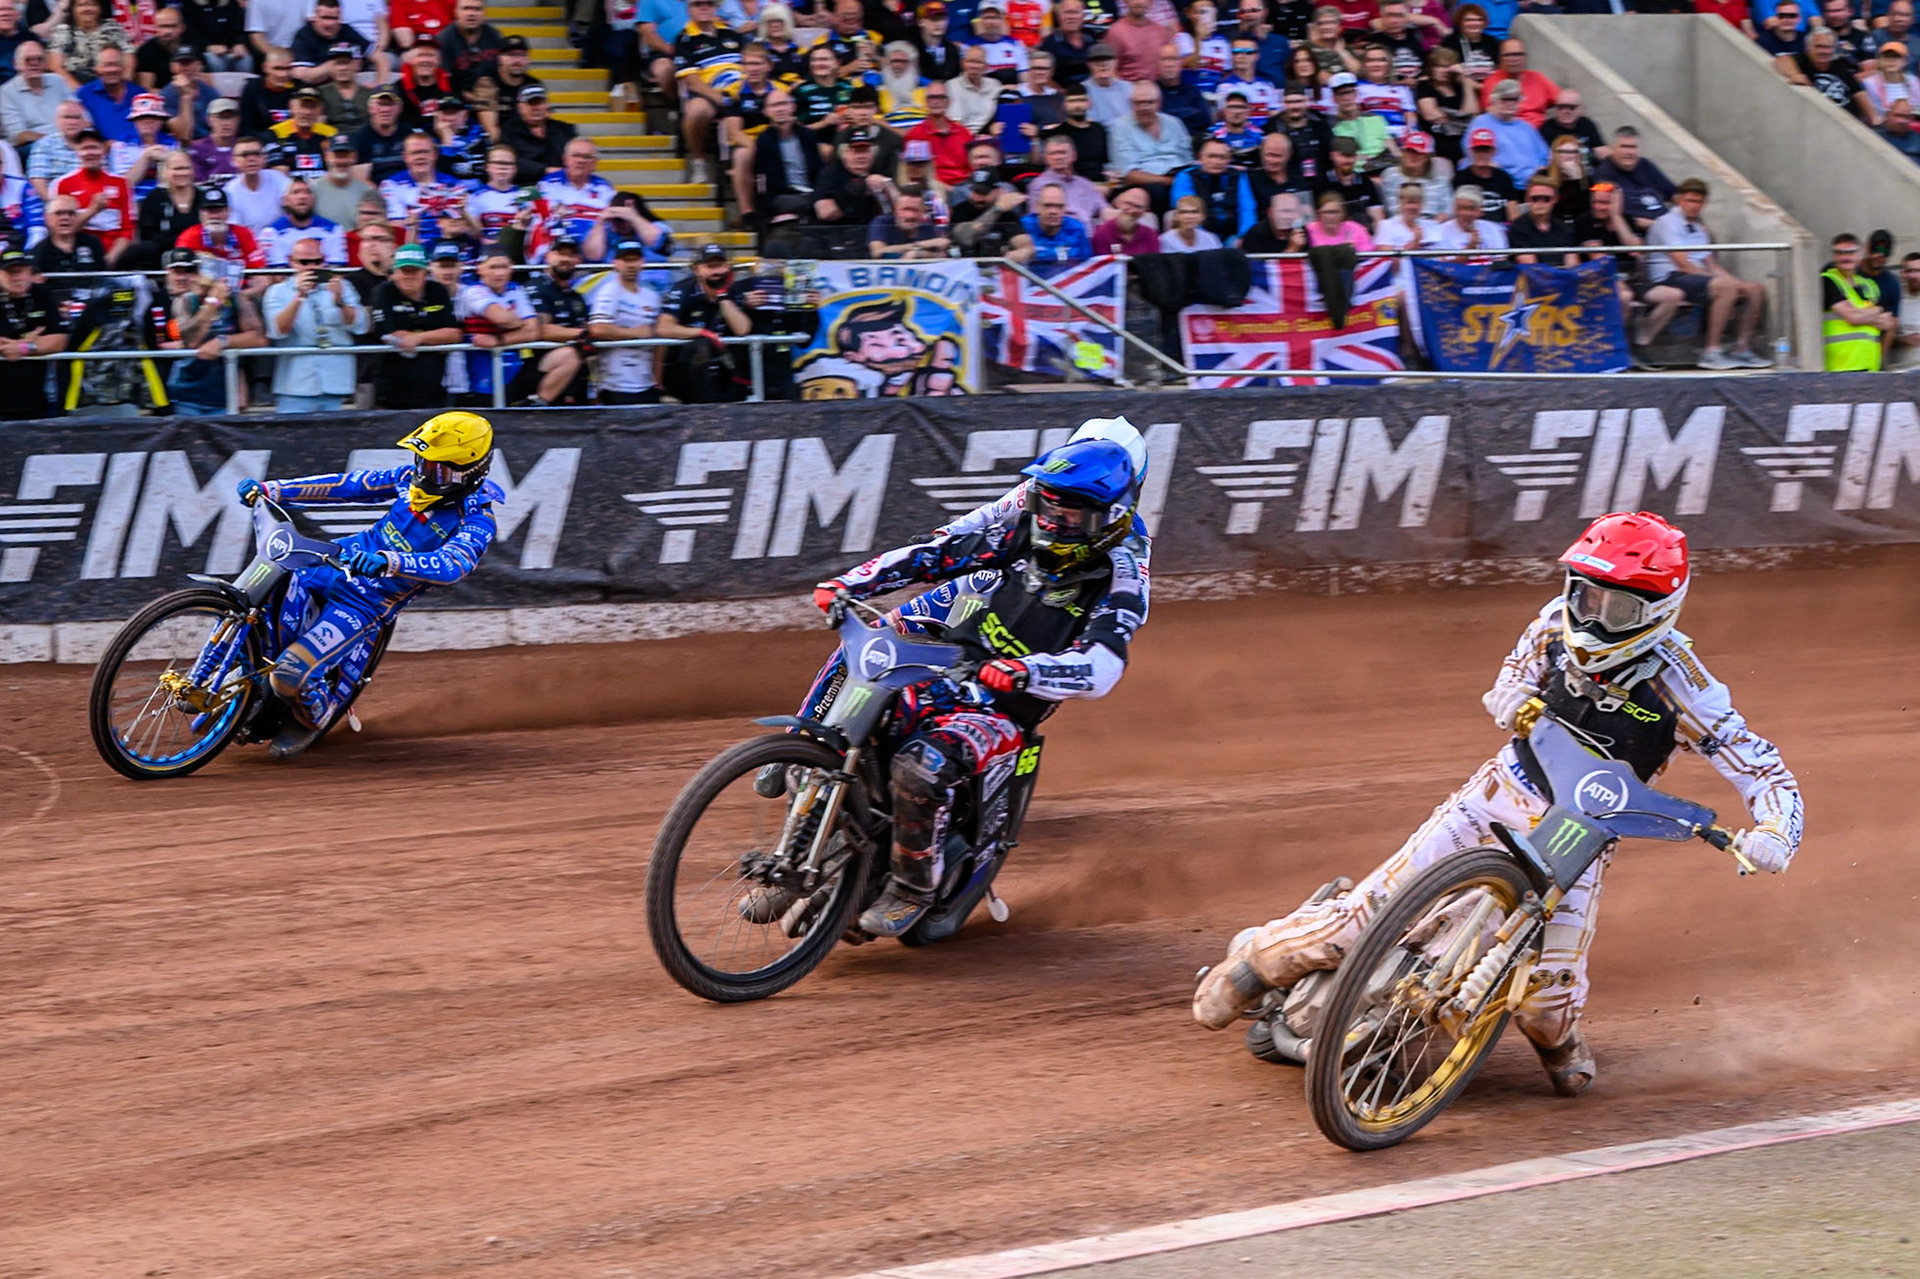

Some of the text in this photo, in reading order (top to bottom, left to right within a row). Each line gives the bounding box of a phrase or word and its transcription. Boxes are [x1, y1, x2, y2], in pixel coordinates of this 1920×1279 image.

[0, 450, 272, 582] FIM
[622, 433, 896, 564] FIM
[1194, 415, 1450, 534] FIM
[1484, 405, 1727, 521] FIM
[403, 555, 441, 570] MCG
[1621, 701, 1662, 723] SGP
[1582, 782, 1619, 808] ATPI
